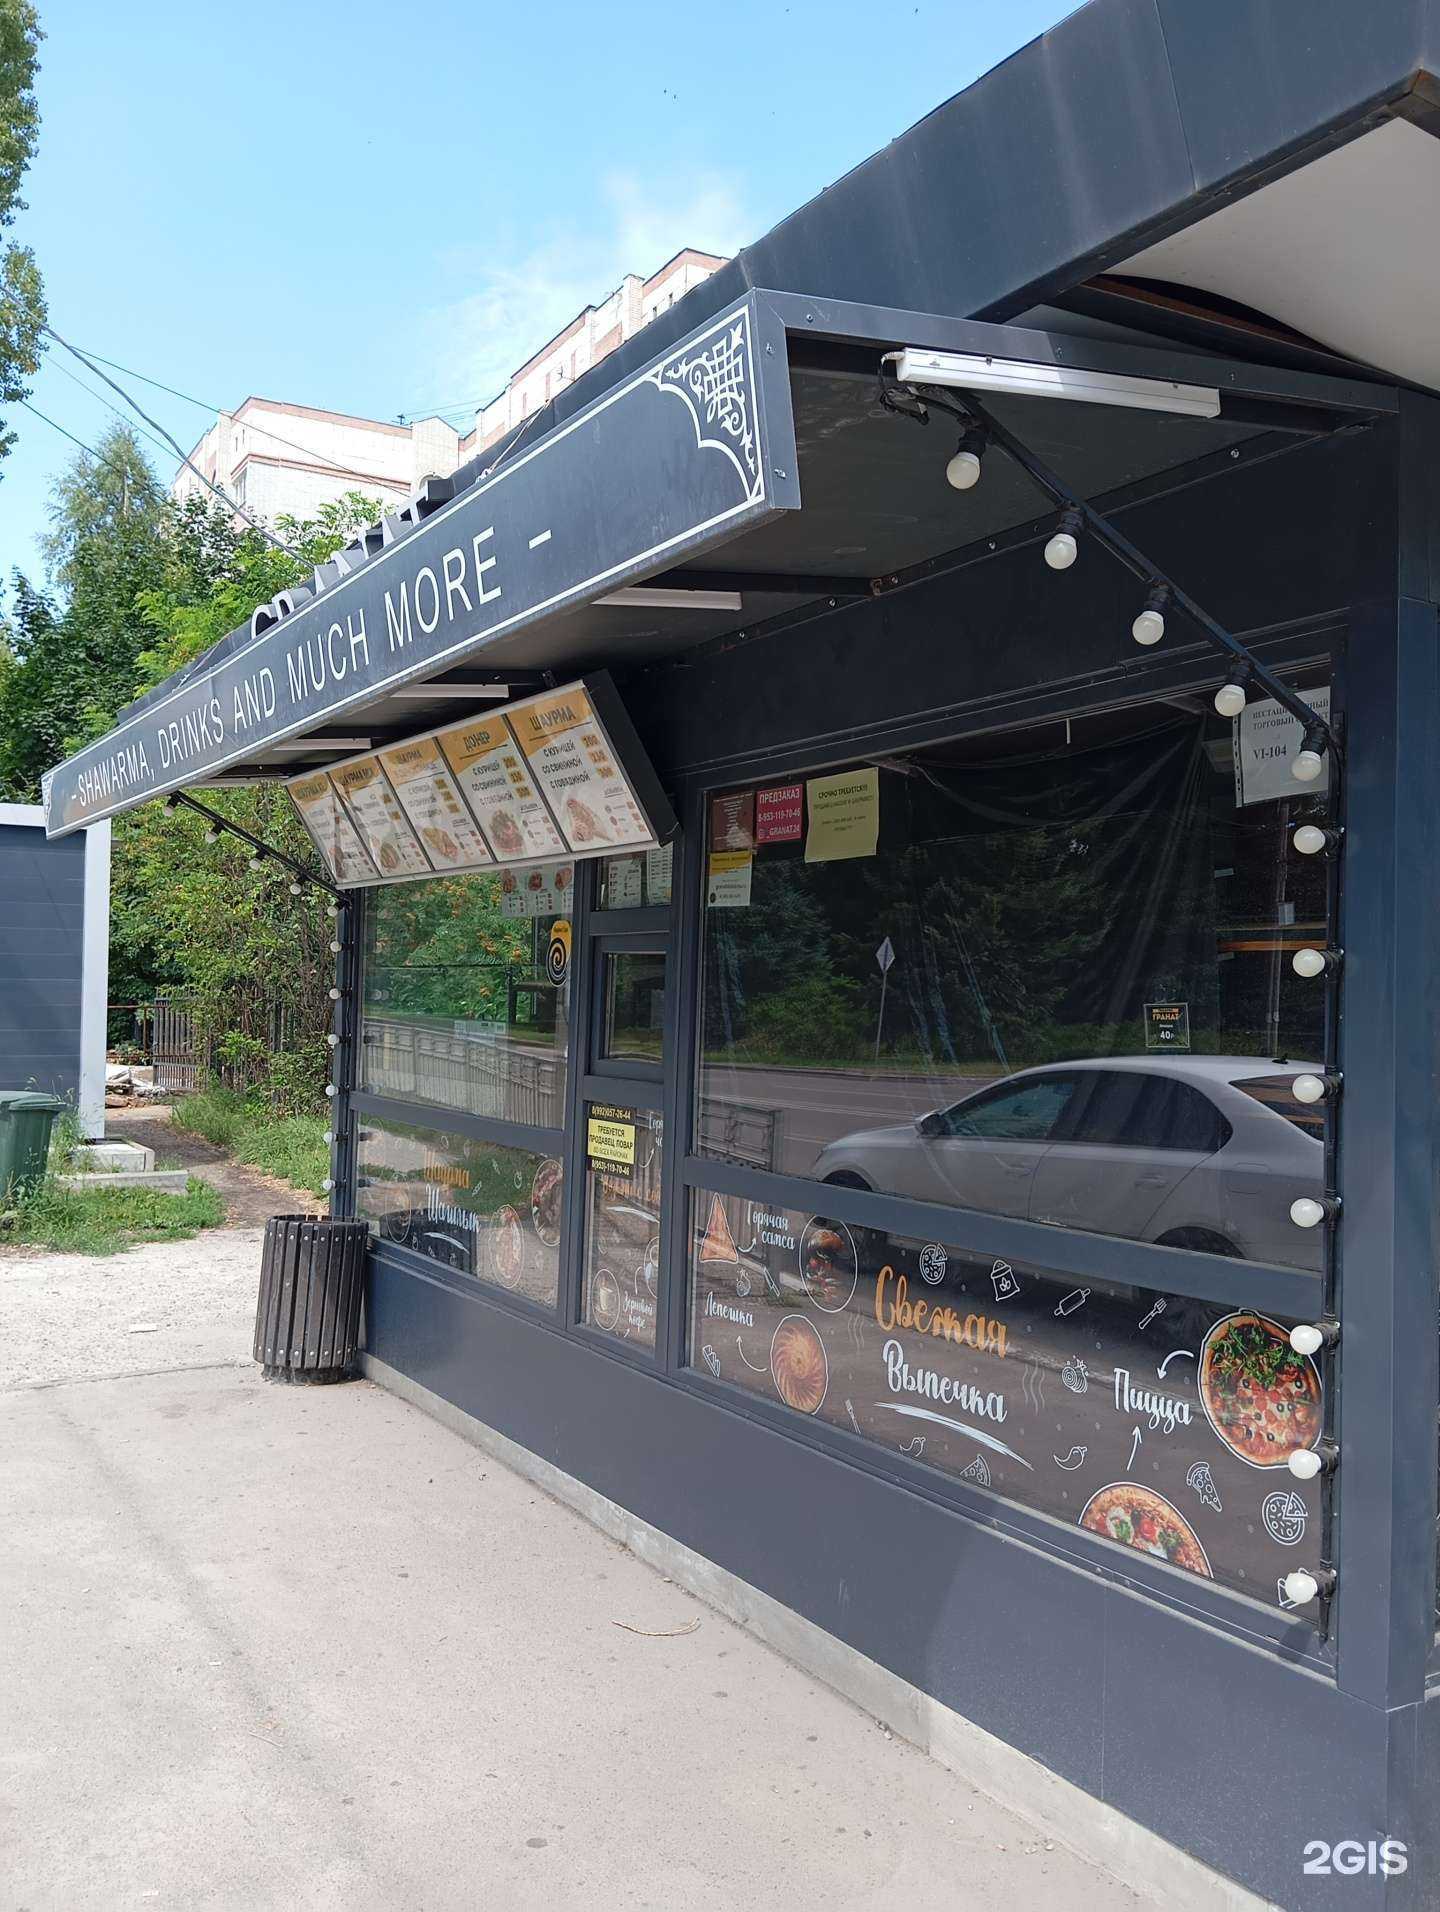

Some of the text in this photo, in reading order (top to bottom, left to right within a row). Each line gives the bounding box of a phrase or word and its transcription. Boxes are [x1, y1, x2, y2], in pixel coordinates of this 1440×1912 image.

[158, 697, 224, 769] DRINKS
[234, 667, 276, 733] AND
[286, 608, 370, 701] MUCH
[384, 526, 502, 652] MORE
[529, 705, 577, 730] ШАУРМА
[463, 730, 491, 753] ДОНЕР
[1253, 743, 1287, 761] VI-104
[760, 788, 800, 804] ПРЕДЗАКАЗ
[589, 1134, 633, 1151] ПРОДАВЕЦ ПОВАР
[597, 1125, 625, 1138] ТРЕБУЕТСЯ
[747, 1201, 788, 1232] Горячая
[761, 1230, 795, 1250] самса
[705, 1291, 754, 1327] Лепешка
[876, 1265, 1007, 1358] Свежая
[882, 1339, 1008, 1423] Выпечка
[1113, 1367, 1194, 1434] Пицца
